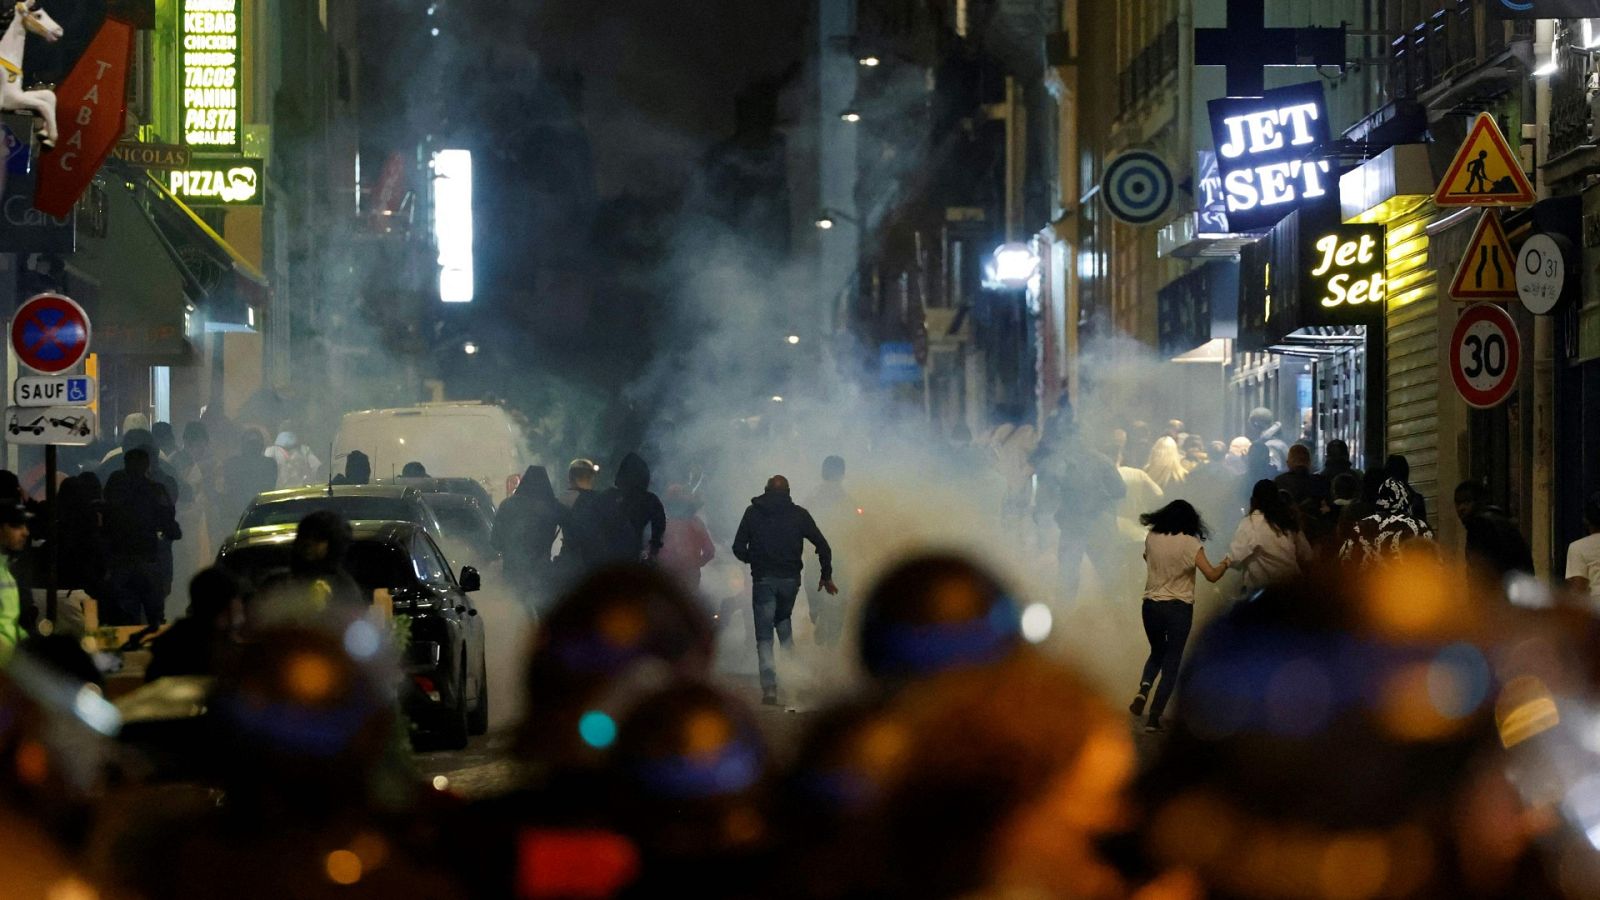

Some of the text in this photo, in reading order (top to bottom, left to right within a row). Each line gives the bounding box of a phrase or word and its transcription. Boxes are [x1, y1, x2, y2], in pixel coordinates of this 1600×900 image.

[184, 12, 236, 33] KEBAB
[184, 35, 237, 50] CHICKEN
[184, 67, 236, 87] TACOS
[185, 88, 236, 108] PANINI
[60, 60, 112, 172] TABAC
[185, 109, 236, 130] PASTA
[1221, 102, 1318, 158] JET
[113, 147, 185, 165] NICOLAS
[171, 171, 226, 196] PIZZA
[1226, 159, 1331, 212] SET
[1311, 233, 1376, 276] Jet
[1321, 273, 1386, 308] Set
[1463, 333, 1506, 379] 30
[21, 383, 65, 399] SAUF
